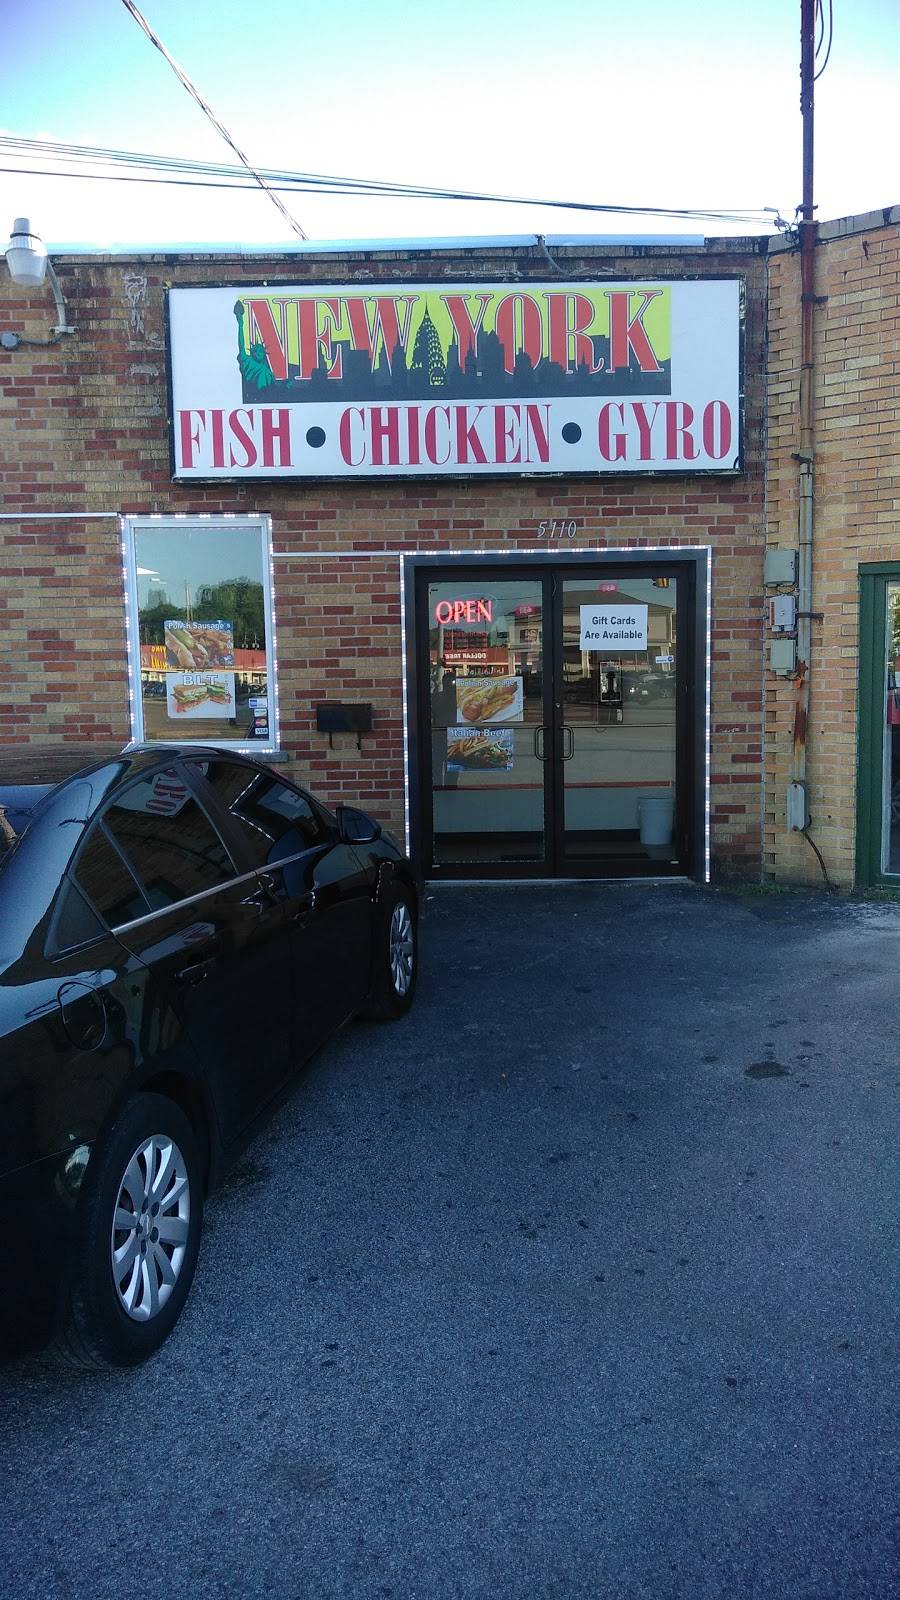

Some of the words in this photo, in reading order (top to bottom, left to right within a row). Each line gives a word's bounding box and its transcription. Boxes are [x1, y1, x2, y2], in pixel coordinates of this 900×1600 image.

[243, 295, 420, 381] NEW
[440, 290, 665, 376] YORK
[177, 408, 295, 469] FISH
[339, 403, 553, 467] CHICKEN
[597, 399, 732, 463] GYRO
[536, 520, 577, 538] 5110
[435, 600, 493, 624] OPEN
[168, 621, 191, 630] Polish
[193, 621, 225, 631] Sausage
[592, 616, 608, 625] Gift
[610, 616, 636, 625] Cards
[584, 630, 600, 640] Are
[602, 630, 643, 640] Available
[183, 675, 219, 686] BLT
